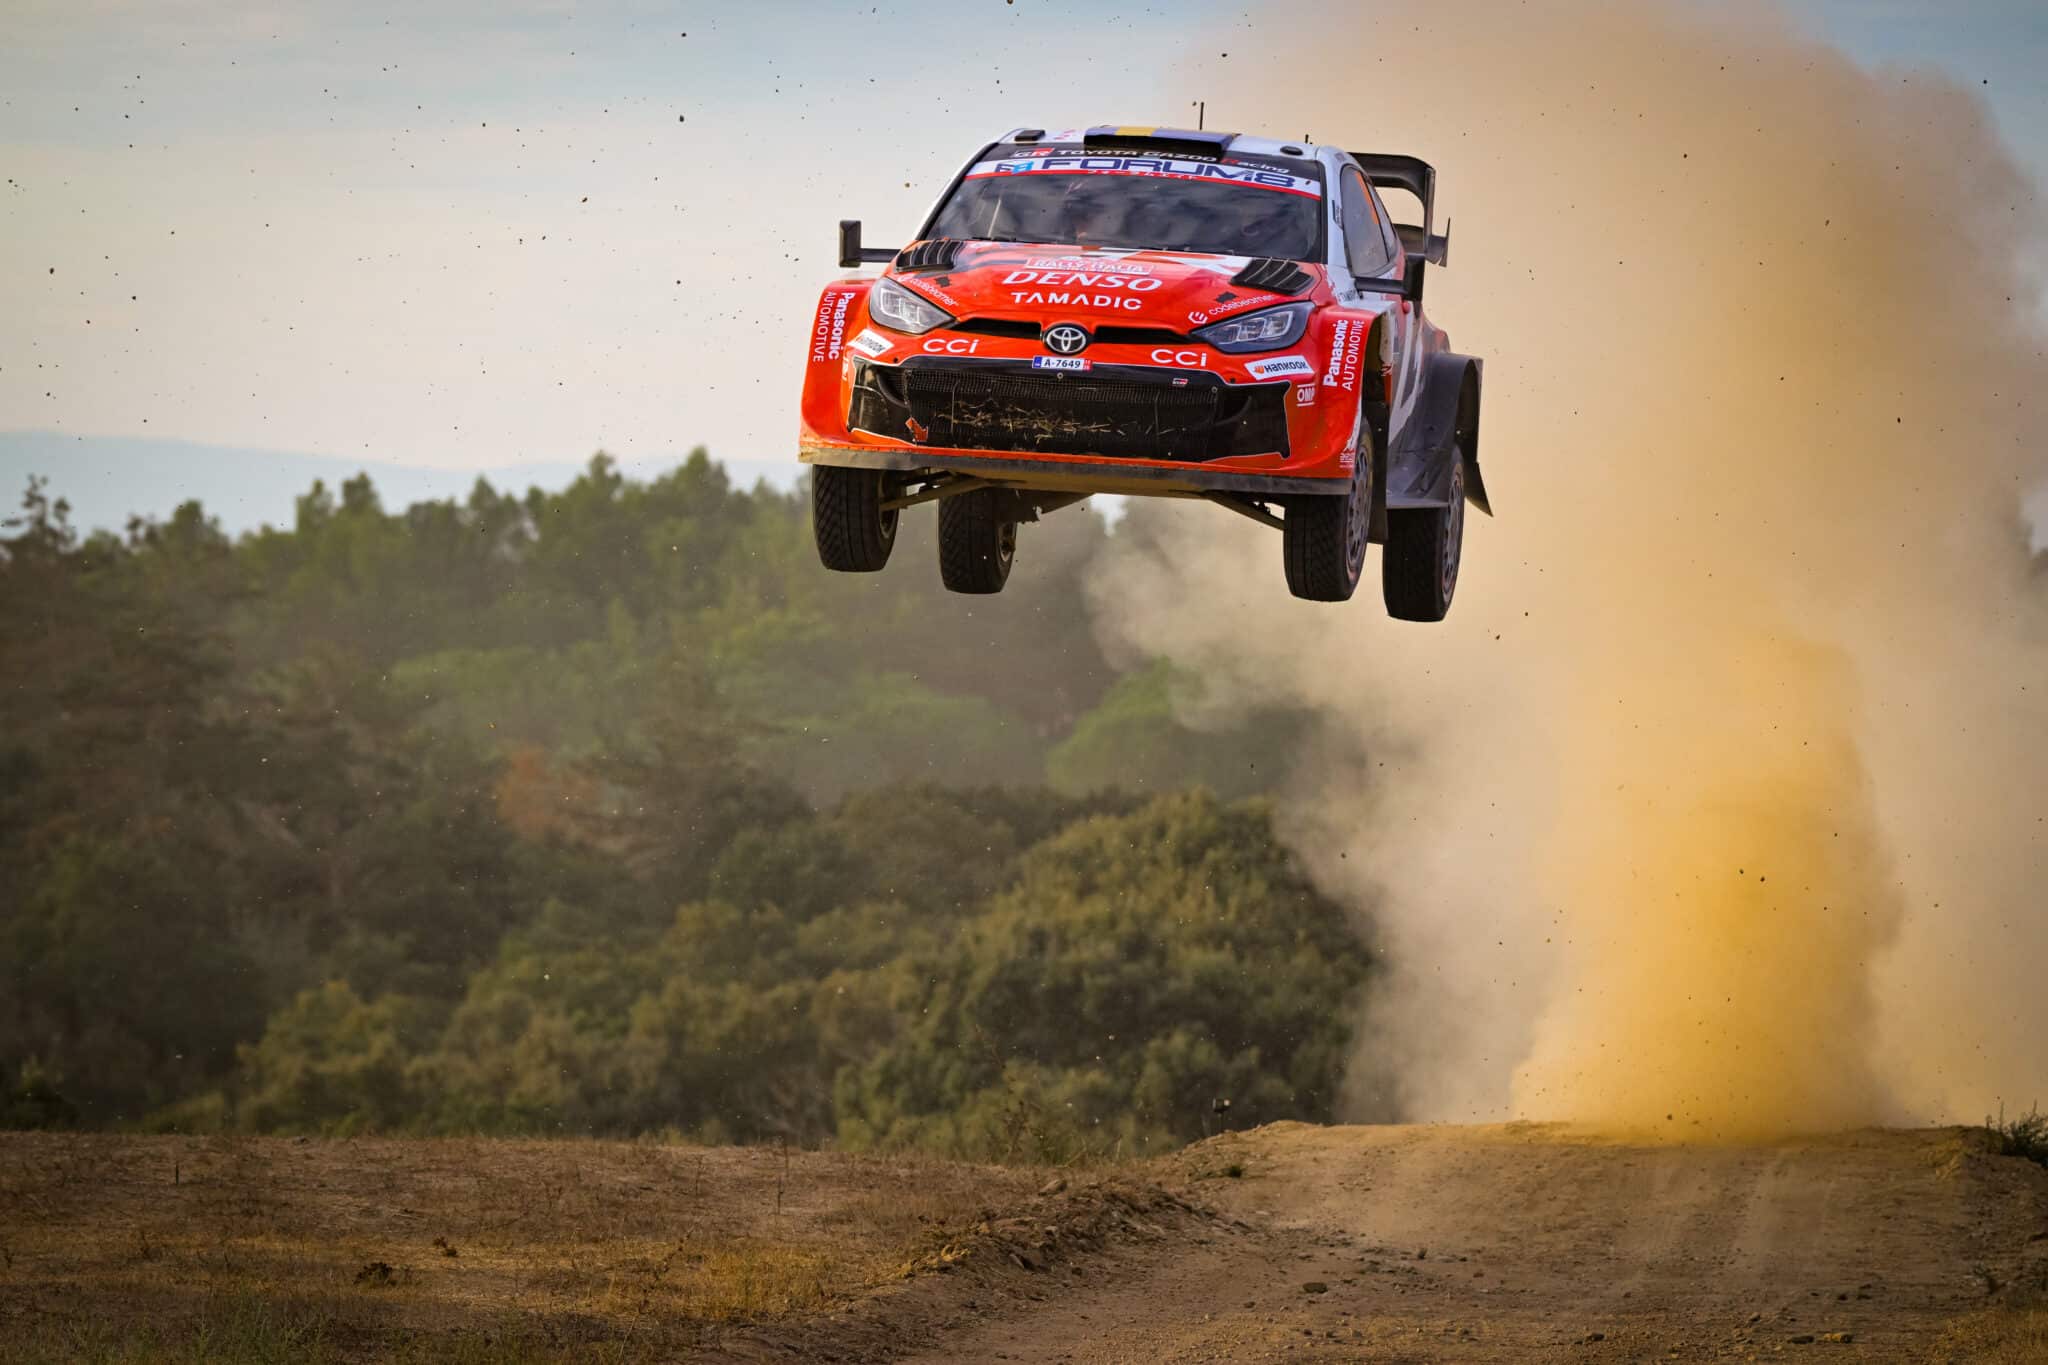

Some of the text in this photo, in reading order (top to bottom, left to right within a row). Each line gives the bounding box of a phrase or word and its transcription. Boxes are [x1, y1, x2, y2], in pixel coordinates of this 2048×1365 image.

[1041, 158, 1295, 188] FORUM8
[1143, 151, 1217, 162] GAZOO
[1220, 158, 1290, 174] Racing
[1003, 271, 1163, 291] DENSO
[1011, 292, 1143, 310] TAMADIC
[1208, 295, 1275, 315] codebeamer
[813, 291, 837, 363] AUTOMOTIVE
[828, 292, 856, 360] Panasonic
[1044, 359, 1081, 369] A-7649
[1323, 319, 1349, 388] Panasonic
[1341, 320, 1365, 392] AUTOMOTIVE
[1297, 387, 1316, 401] OMP
